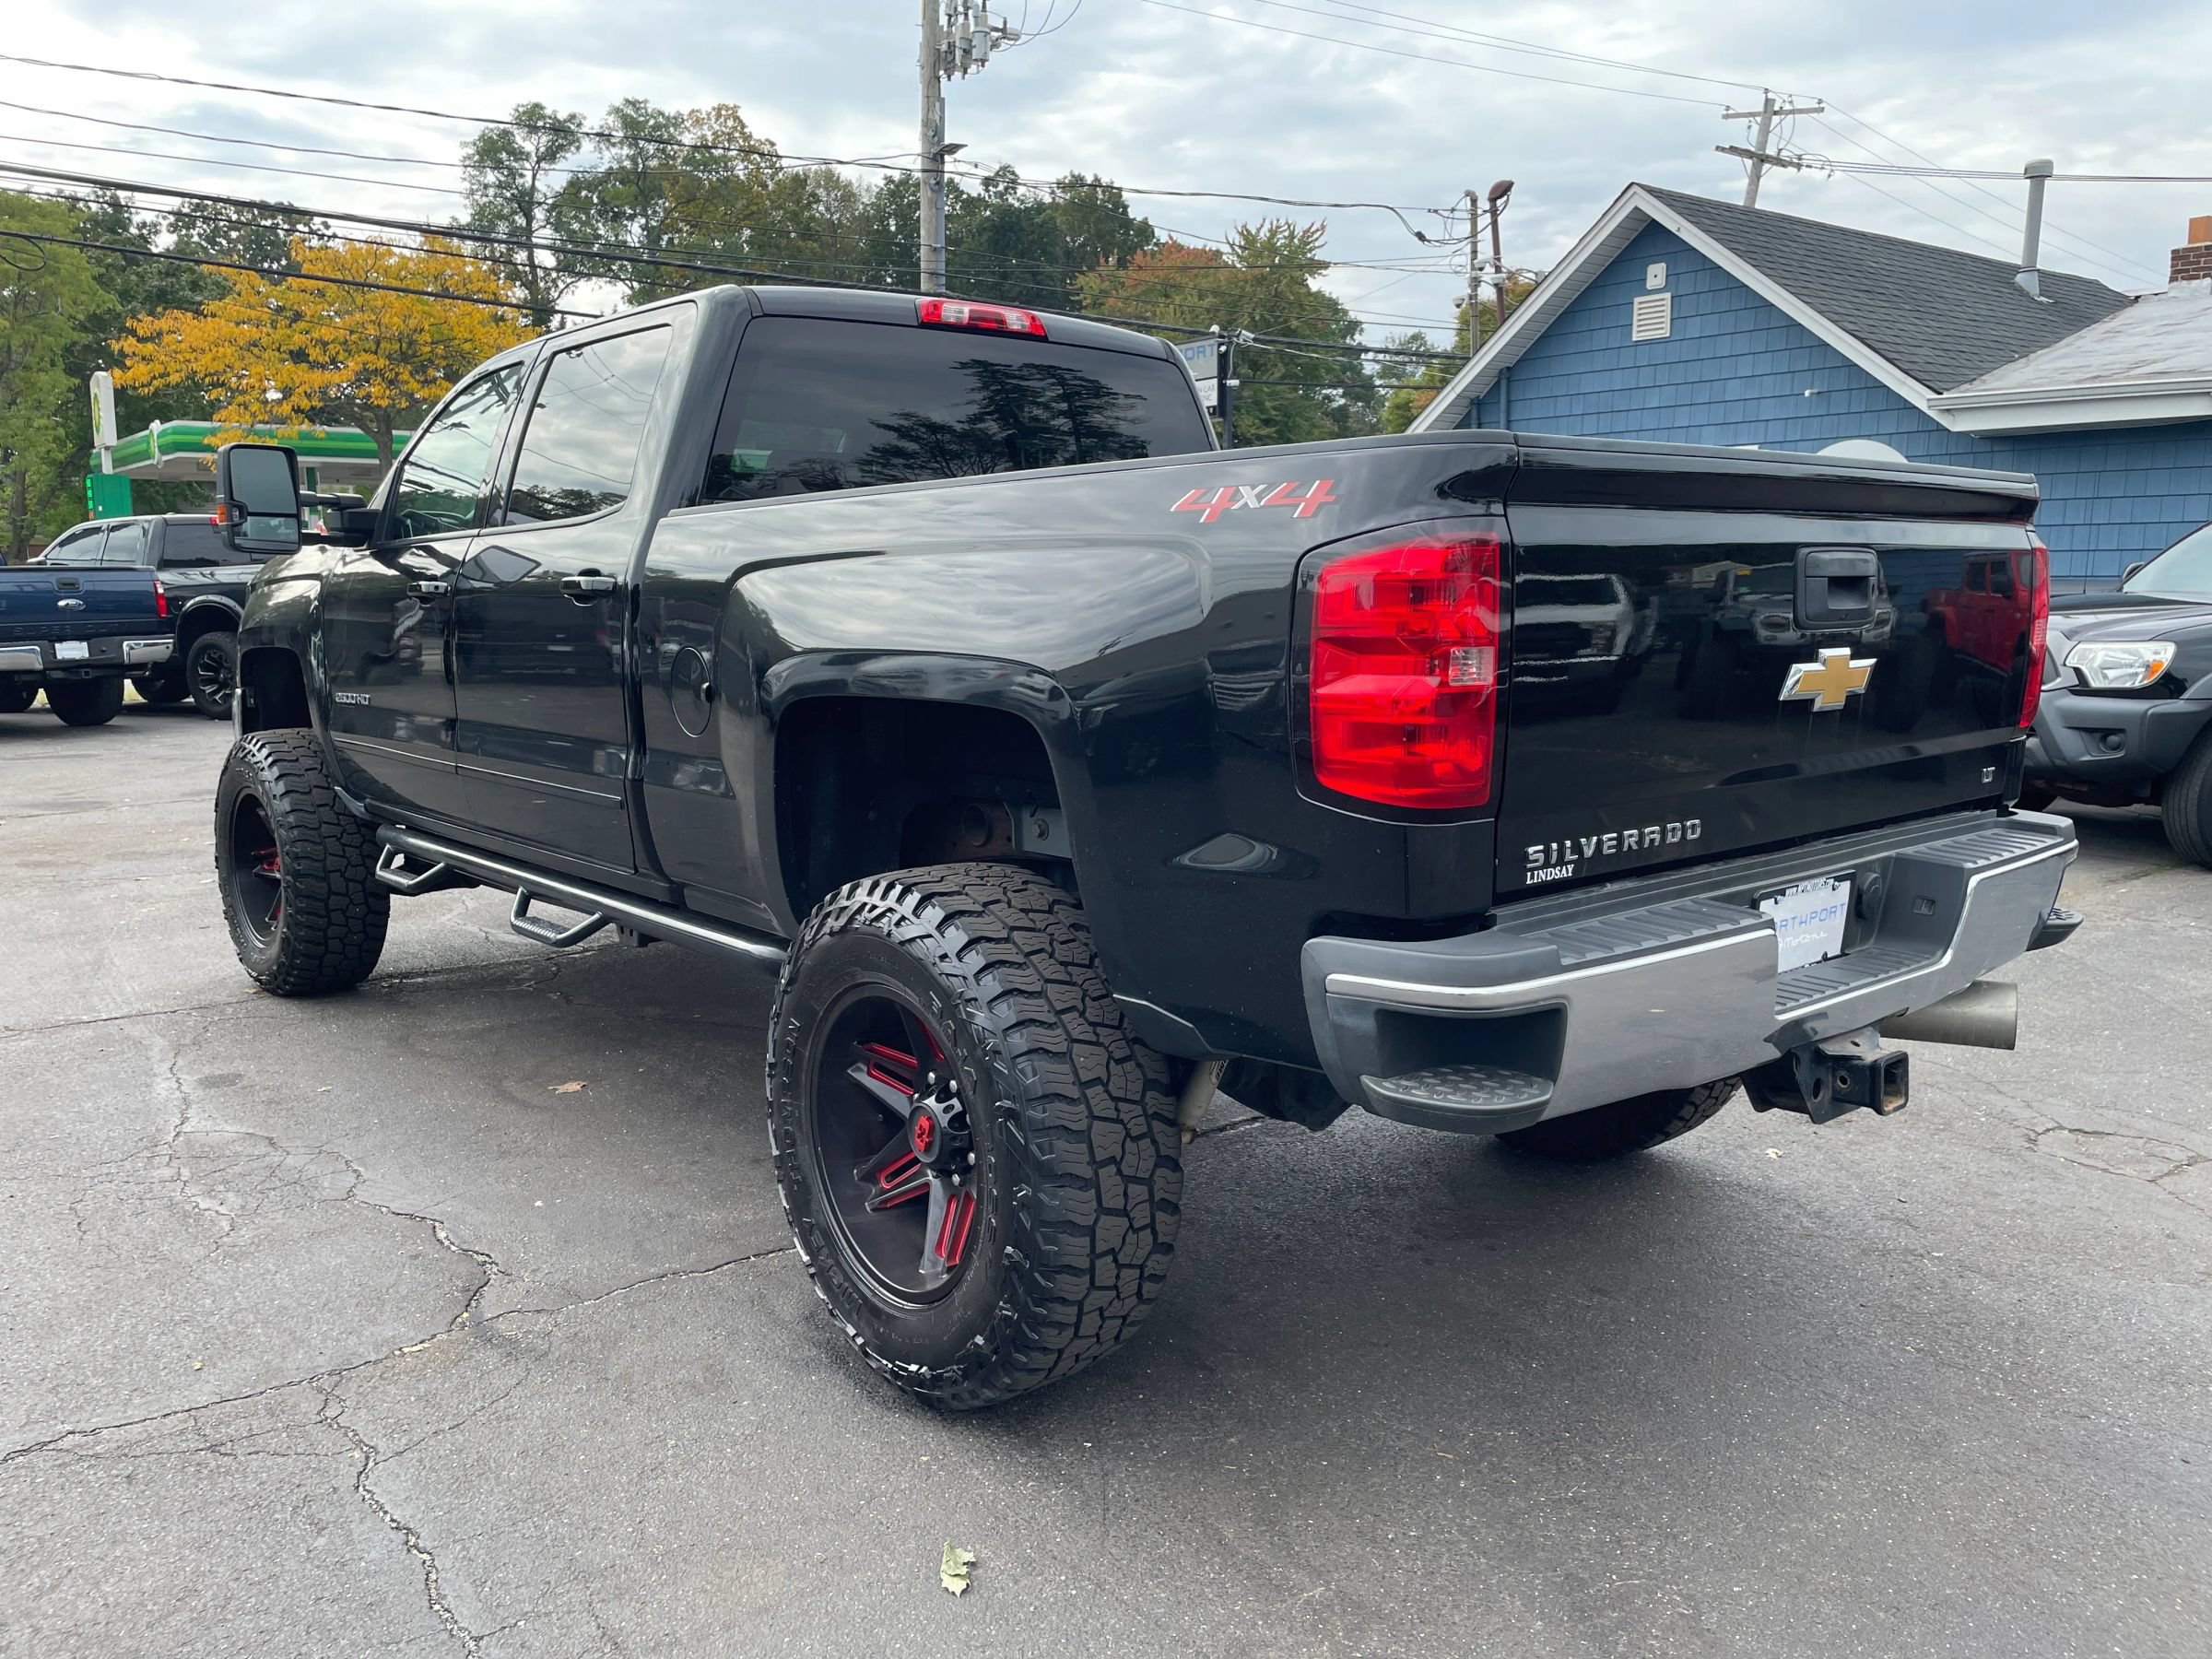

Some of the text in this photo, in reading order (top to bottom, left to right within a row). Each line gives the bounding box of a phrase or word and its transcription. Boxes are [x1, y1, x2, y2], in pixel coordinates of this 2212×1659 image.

[13, 625, 73, 635] SUPER
[1982, 766, 1995, 783] LT
[1524, 818, 1702, 869] SILVERADO
[1526, 864, 1575, 885] LINDSAY
[1775, 903, 1846, 934] RTHPORT
[801, 1217, 864, 1316] MICKEY
